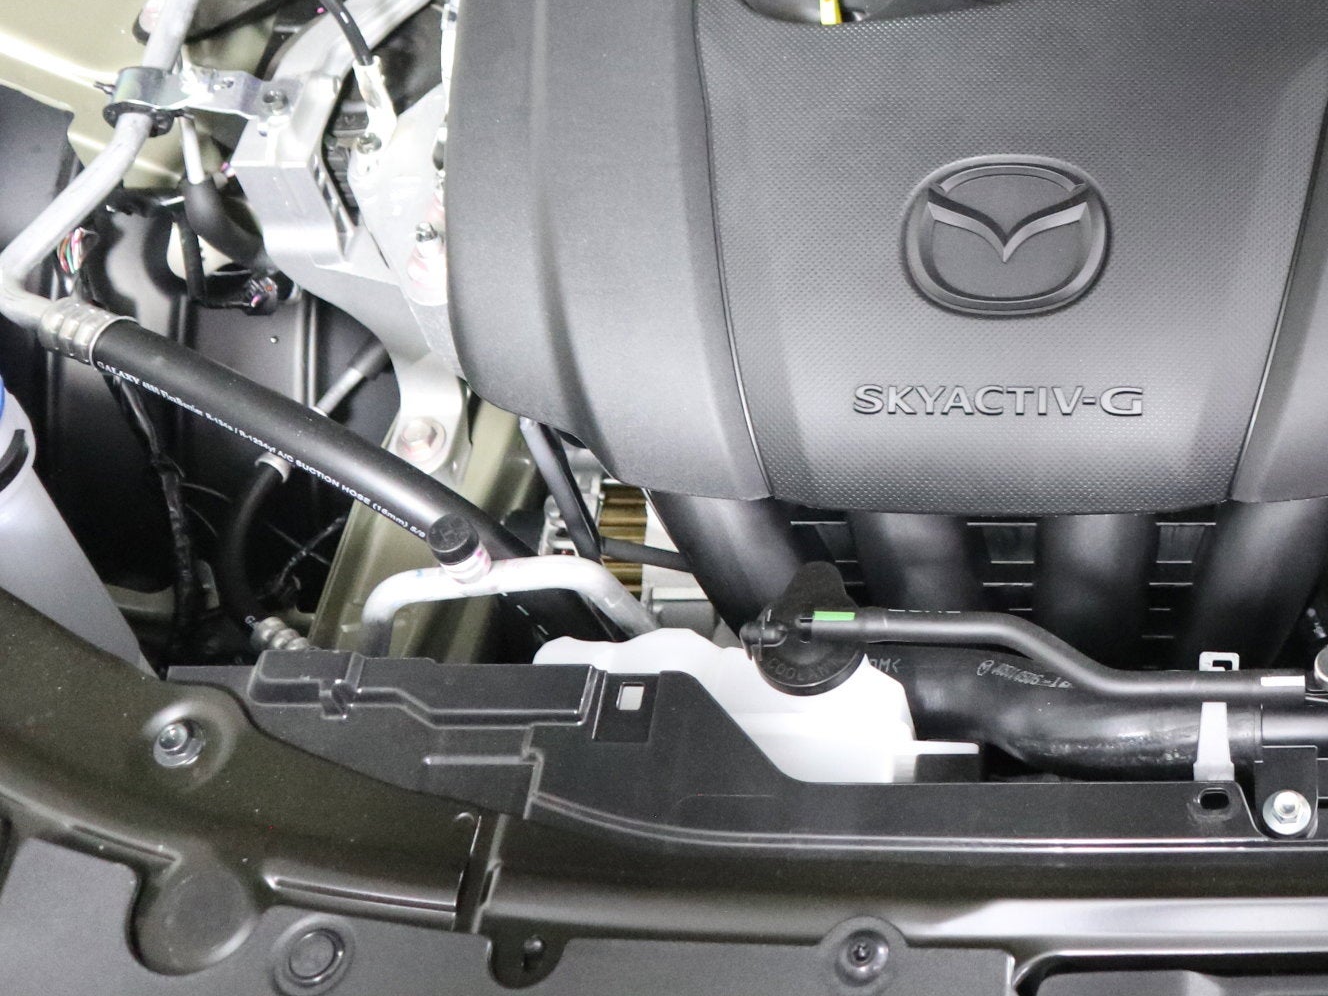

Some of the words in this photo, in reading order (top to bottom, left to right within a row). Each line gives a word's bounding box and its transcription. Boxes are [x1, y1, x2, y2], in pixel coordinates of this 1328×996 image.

[96, 361, 140, 385] GALAXY
[277, 450, 295, 463] A/C
[295, 459, 340, 487] SUCTION
[341, 485, 371, 505] HOSE
[372, 503, 409, 528] (16mm)
[853, 384, 1143, 416] SKYACTIV-G
